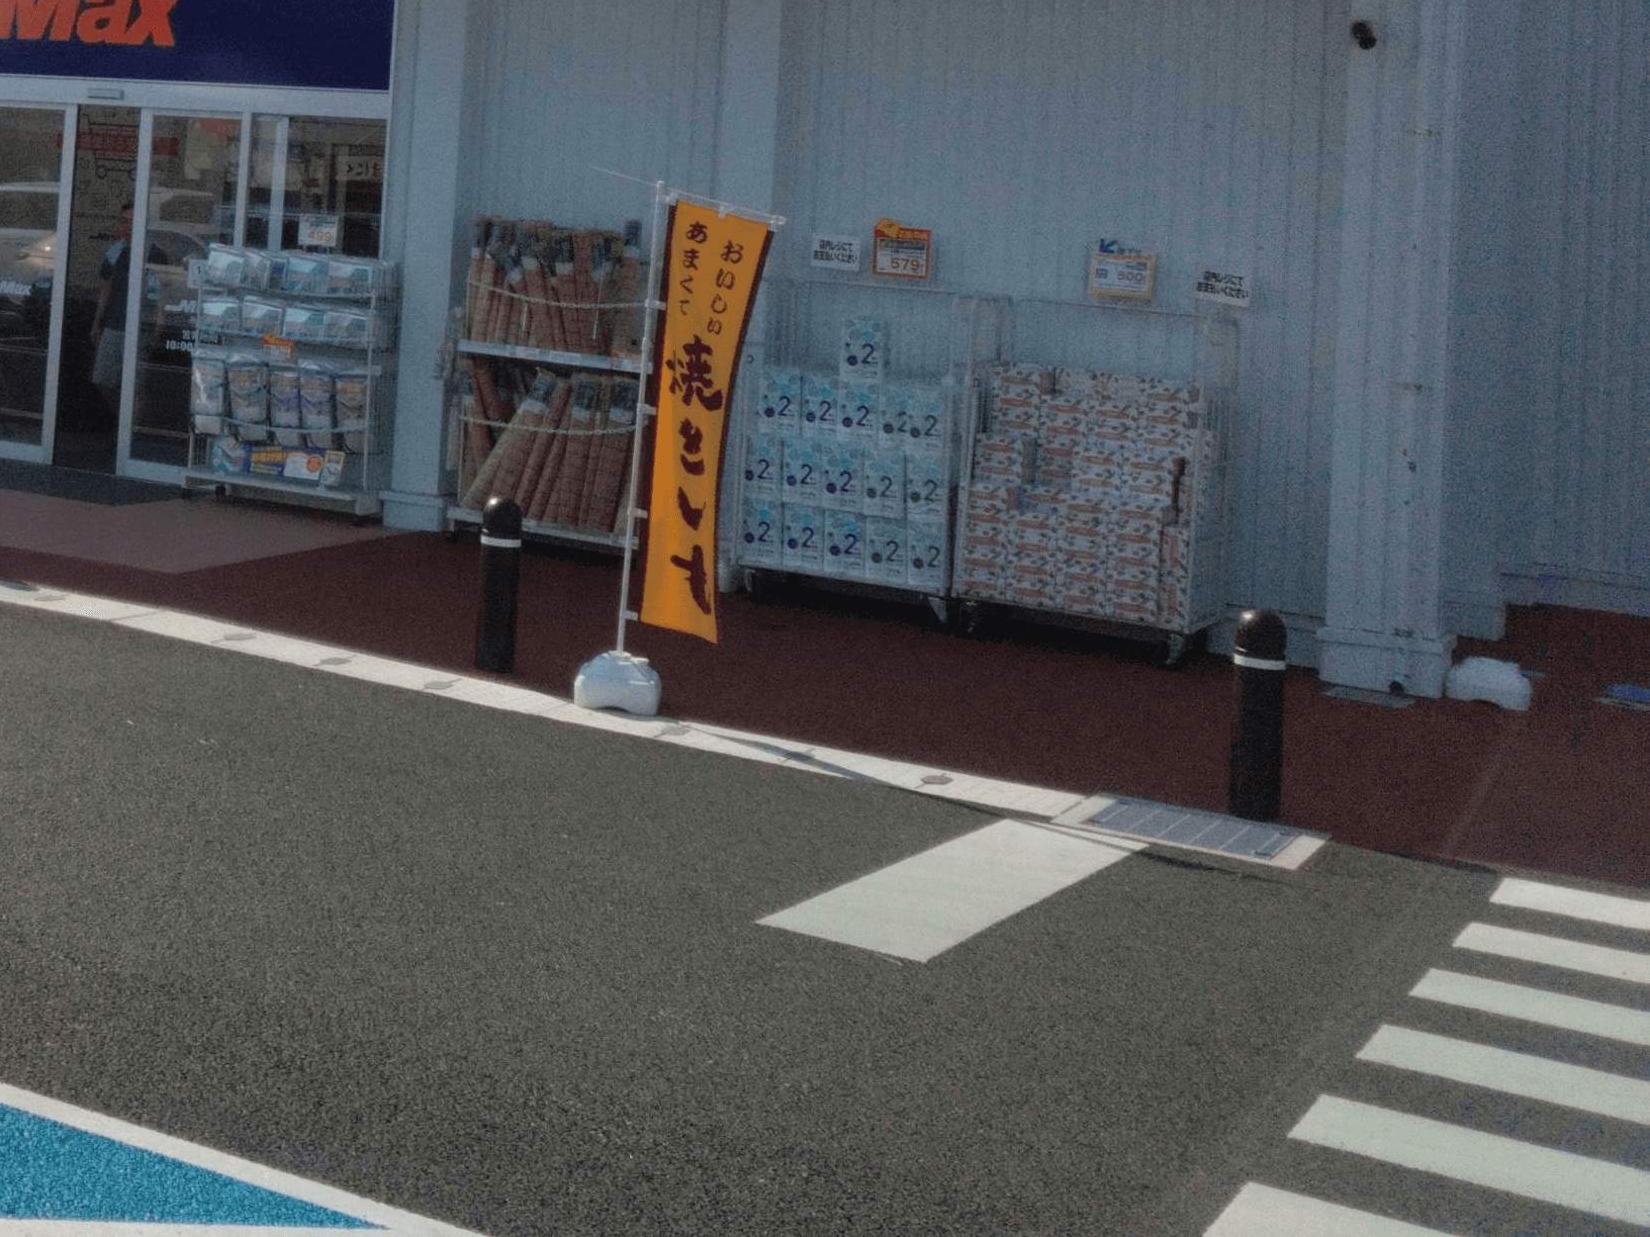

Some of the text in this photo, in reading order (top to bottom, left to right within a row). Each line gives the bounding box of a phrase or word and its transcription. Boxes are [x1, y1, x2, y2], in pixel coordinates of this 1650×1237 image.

[679, 220, 709, 316] あまくて
[891, 256, 921, 272] 579
[706, 239, 745, 336] おいしい
[861, 343, 875, 364] 2
[778, 396, 791, 416] 2
[819, 400, 832, 422] 2
[856, 405, 870, 426] 2
[897, 412, 907, 432] 2
[924, 415, 938, 437] 2
[665, 333, 724, 615] 焼きいも
[757, 459, 770, 479] 2
[800, 464, 813, 485] 2
[840, 470, 853, 493] 2
[880, 476, 892, 497] 2
[924, 479, 938, 501] 2
[757, 521, 771, 542] 2
[801, 527, 814, 548] 2
[844, 534, 858, 555] 2
[885, 540, 899, 562] 2
[927, 546, 940, 567] 2
